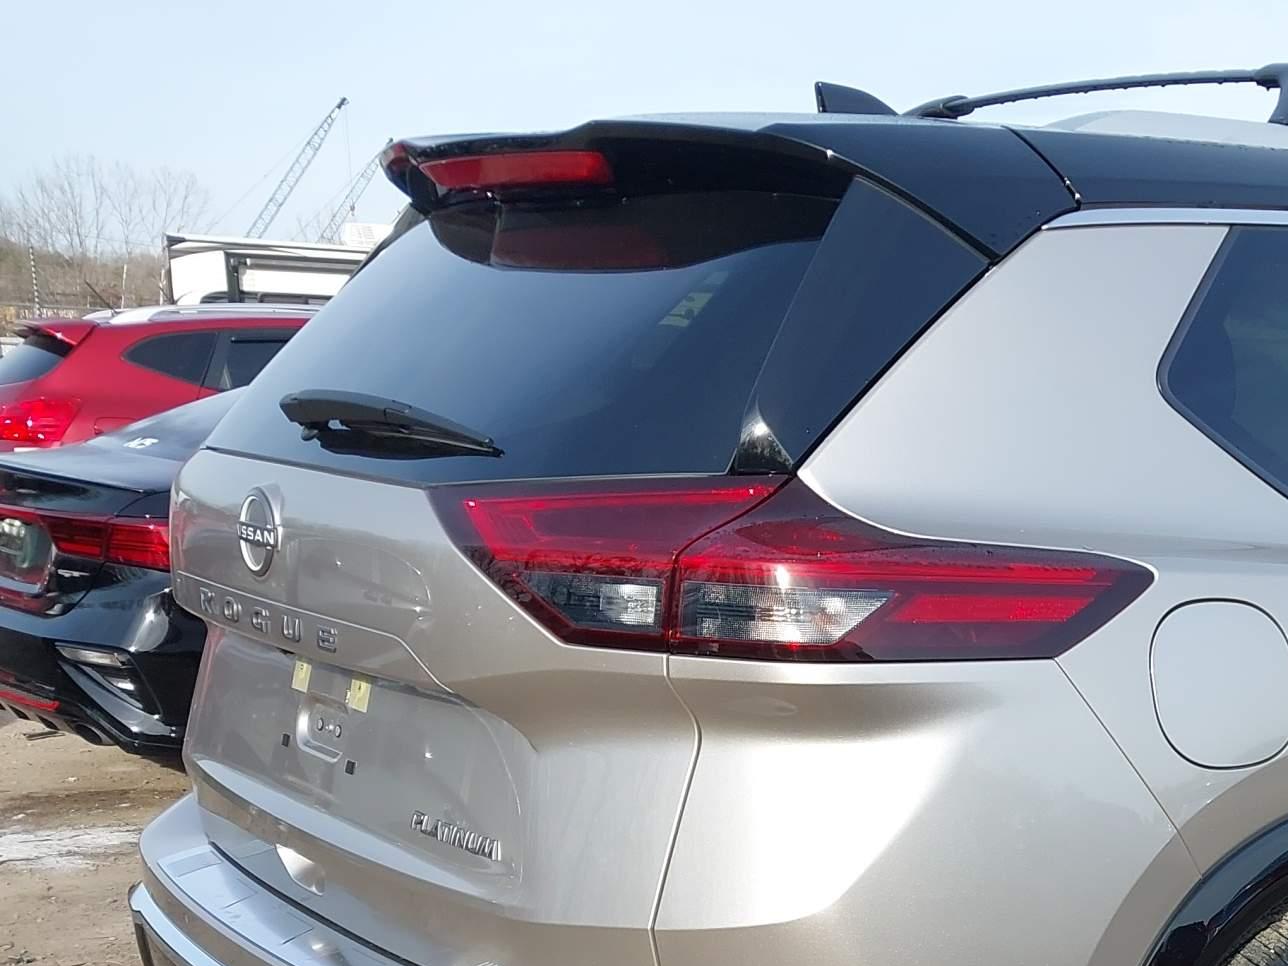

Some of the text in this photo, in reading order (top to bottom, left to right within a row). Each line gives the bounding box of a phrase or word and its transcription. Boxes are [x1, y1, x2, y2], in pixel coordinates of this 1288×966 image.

[235, 522, 275, 546] ISSAN
[200, 587, 338, 653] ROGUE
[411, 809, 502, 862] PLATINUM
